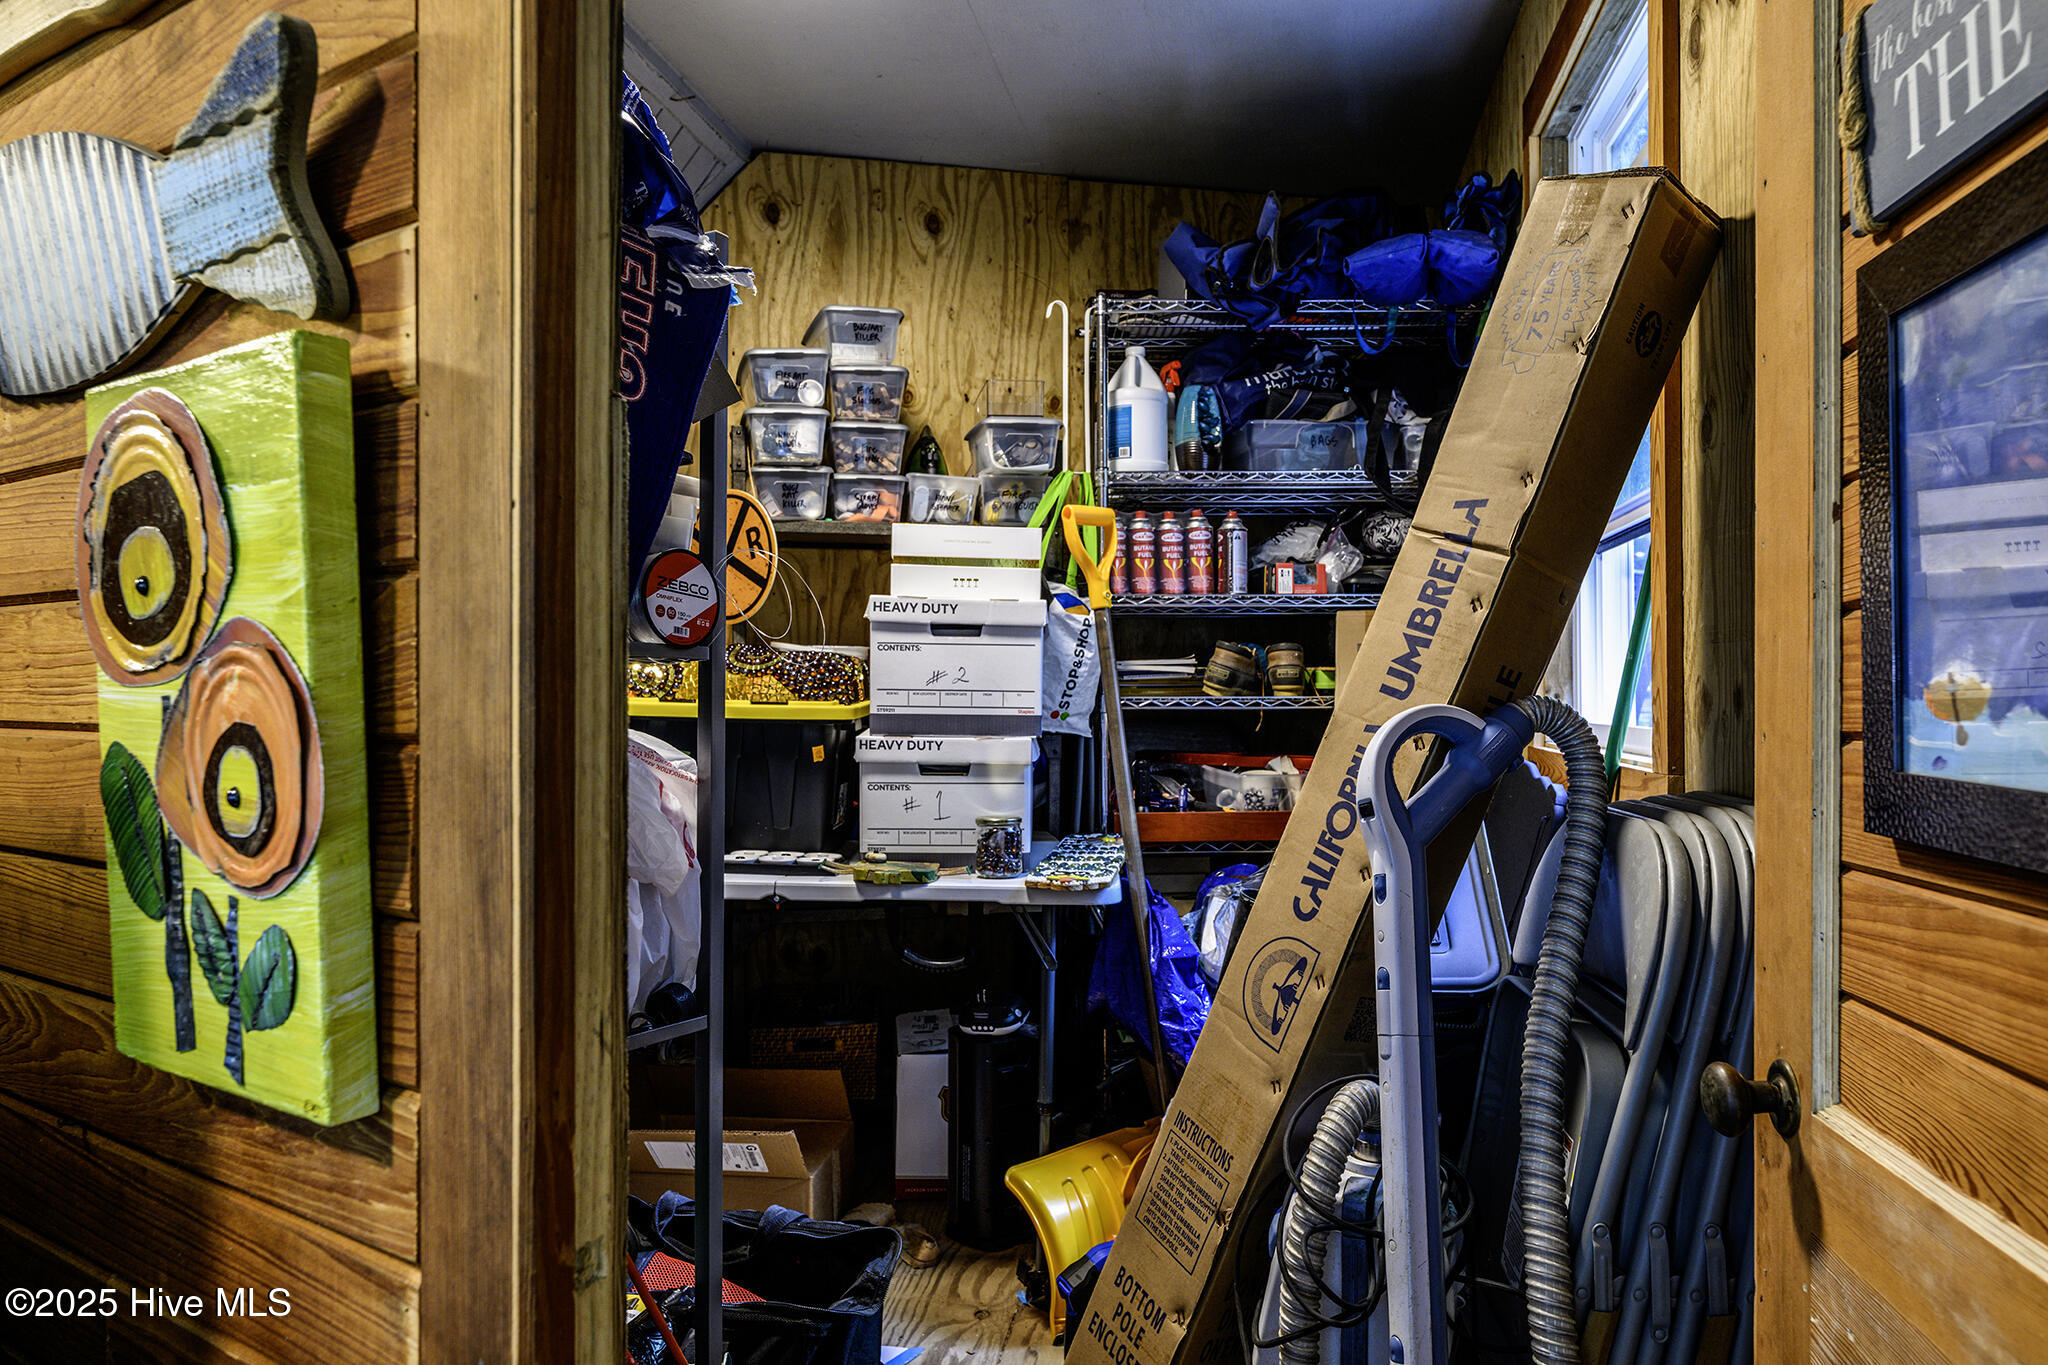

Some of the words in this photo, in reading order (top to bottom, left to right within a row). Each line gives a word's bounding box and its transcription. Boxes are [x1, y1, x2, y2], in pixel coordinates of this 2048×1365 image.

[1894, 0, 2032, 160] THE
[1513, 288, 1529, 322] OVER
[1526, 310, 1549, 341] 75
[1539, 260, 1564, 304] YEARS
[1562, 305, 1573, 321] OF
[854, 332, 881, 343] KILLER
[1625, 302, 1646, 344] CAUTION
[1310, 433, 1338, 448] BAGS
[782, 499, 807, 509] KILLER
[746, 526, 765, 560] R
[656, 575, 709, 596] ZEBCO
[656, 593, 683, 603] OMNIFLEX
[1379, 499, 1490, 700] UMBRELLA
[873, 601, 918, 613] HEAVY
[921, 603, 959, 614] DUTY
[877, 644, 922, 652] CONTENTS:
[1059, 617, 1092, 710] STOP&SHOP
[952, 666, 970, 685] 2
[859, 740, 902, 751] HEAVY
[906, 740, 944, 751] DUTY
[867, 784, 912, 792] CONTENTS:
[934, 791, 951, 821] 1
[1170, 1148, 1185, 1166] TABLE.
[1173, 1109, 1234, 1174] INSTRUCTIONS
[1173, 1140, 1187, 1157] PLACE
[1186, 1152, 1206, 1174] BOTTOM
[1205, 1169, 1218, 1185] POLE
[1216, 1179, 1223, 1190] IN
[1156, 1181, 1171, 1199] COVER
[1159, 1173, 1175, 1191] SHAKE
[1174, 1187, 1184, 1200] THE
[1183, 1196, 1209, 1224] UMBRELLA
[1166, 1156, 1180, 1173] AFTER
[1178, 1168, 1196, 1188] PLACING
[1194, 1183, 1218, 1209] UMBRELLA
[1149, 1221, 1158, 1234] THE
[1157, 1229, 1167, 1242] TOP
[1155, 1215, 1165, 1229] THE
[1164, 1224, 1174, 1238] RED
[1173, 1233, 1185, 1249] STOP
[1183, 1244, 1193, 1258] PIN
[1160, 1208, 1173, 1225] UNTIL
[1172, 1220, 1182, 1234] THE
[1167, 1204, 1177, 1217] THE
[1176, 1212, 1201, 1241] UMBRELLA
[1114, 1265, 1167, 1334] BOTTOM
[1088, 1311, 1142, 1365] ENCLOS
[1112, 1301, 1146, 1350] POLE
